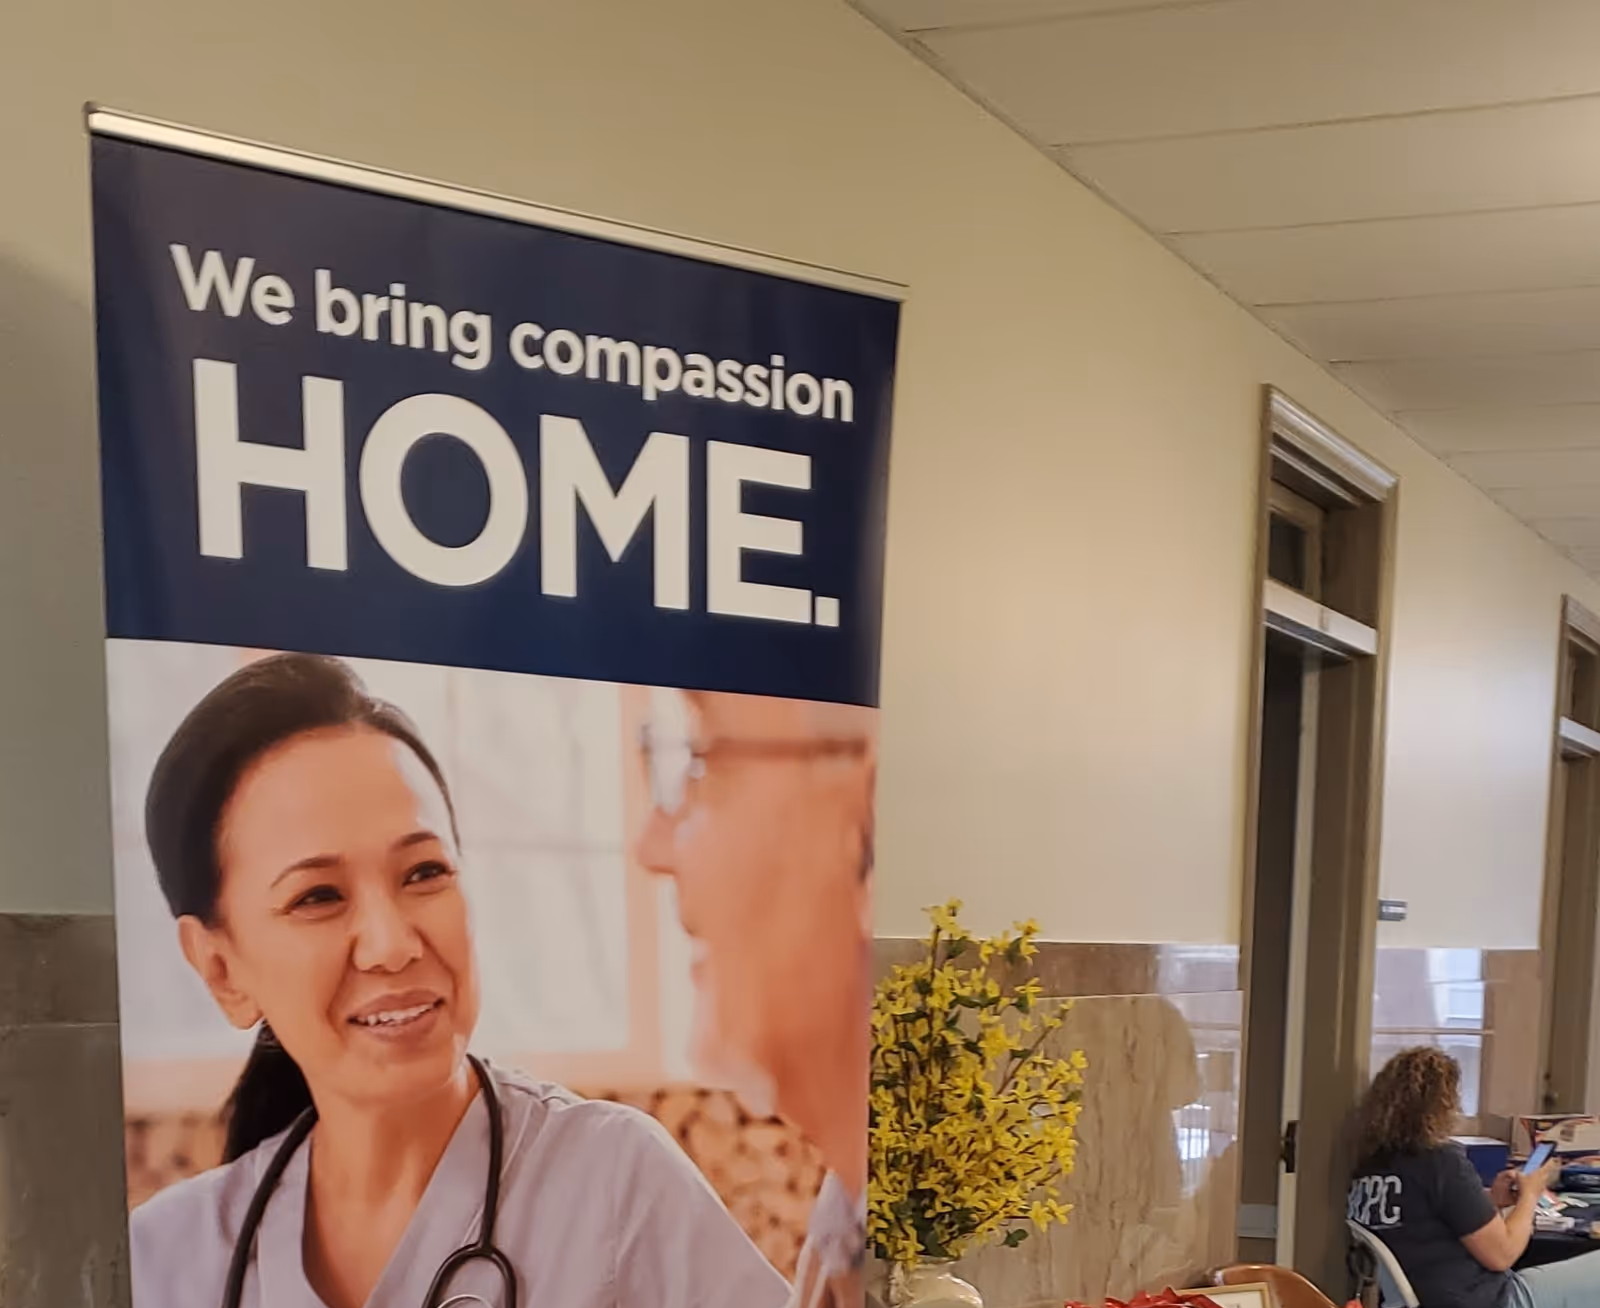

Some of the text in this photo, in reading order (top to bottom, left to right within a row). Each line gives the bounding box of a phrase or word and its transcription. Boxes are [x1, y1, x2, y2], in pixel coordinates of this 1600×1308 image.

[168, 243, 854, 423] We bring compassion
[192, 357, 840, 628] HOME.
